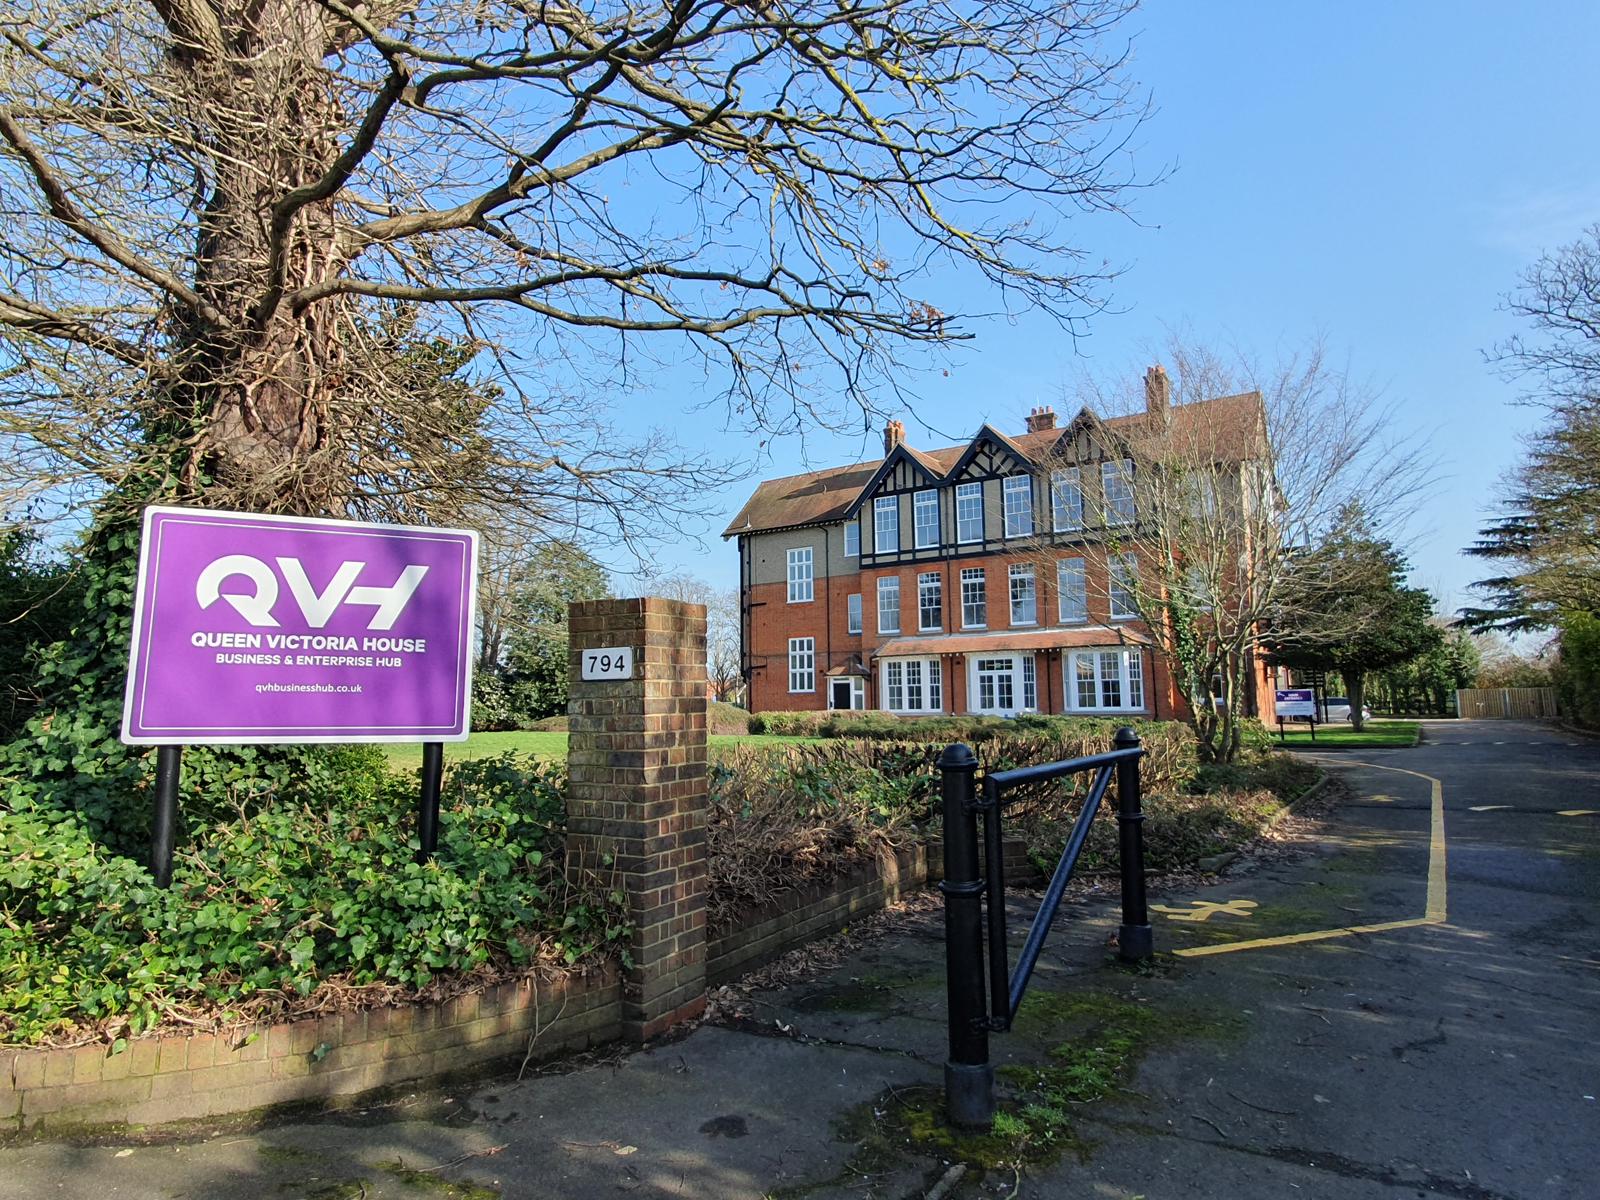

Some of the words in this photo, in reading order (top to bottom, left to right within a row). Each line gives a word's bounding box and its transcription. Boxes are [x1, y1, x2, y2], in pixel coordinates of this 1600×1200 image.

[196, 554, 430, 631] QVH
[190, 631, 262, 649] QUEEN
[266, 634, 358, 652] VICTORIA
[363, 637, 426, 653] HOUSE
[215, 653, 281, 666] BUSINESS
[284, 655, 293, 666] &
[296, 655, 373, 668] ENTERPRISE
[376, 657, 402, 668] HUB
[588, 654, 625, 673] 794
[255, 682, 362, 694] qvhbusinesshub.co.uk
